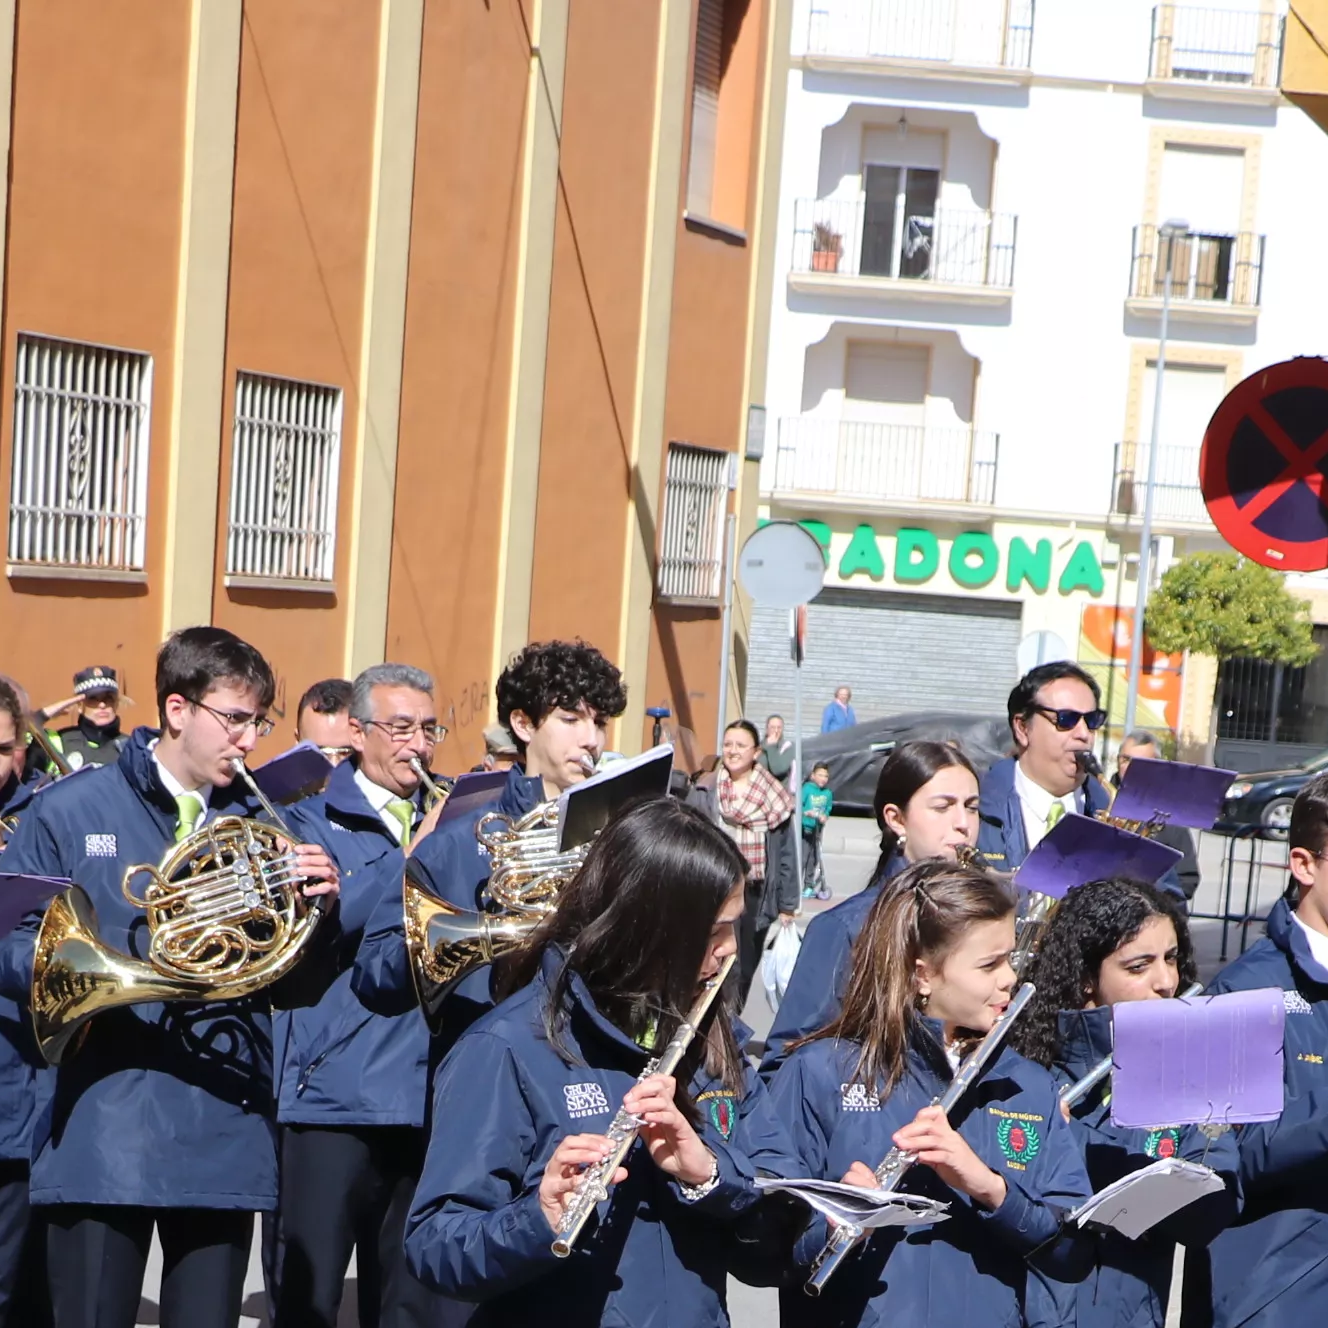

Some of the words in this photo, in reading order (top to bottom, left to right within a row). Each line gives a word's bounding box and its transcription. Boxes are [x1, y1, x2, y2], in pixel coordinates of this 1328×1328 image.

[86, 842, 117, 853] SEYS
[563, 1083, 602, 1097] GRUPO
[566, 1092, 608, 1111] SEYS
